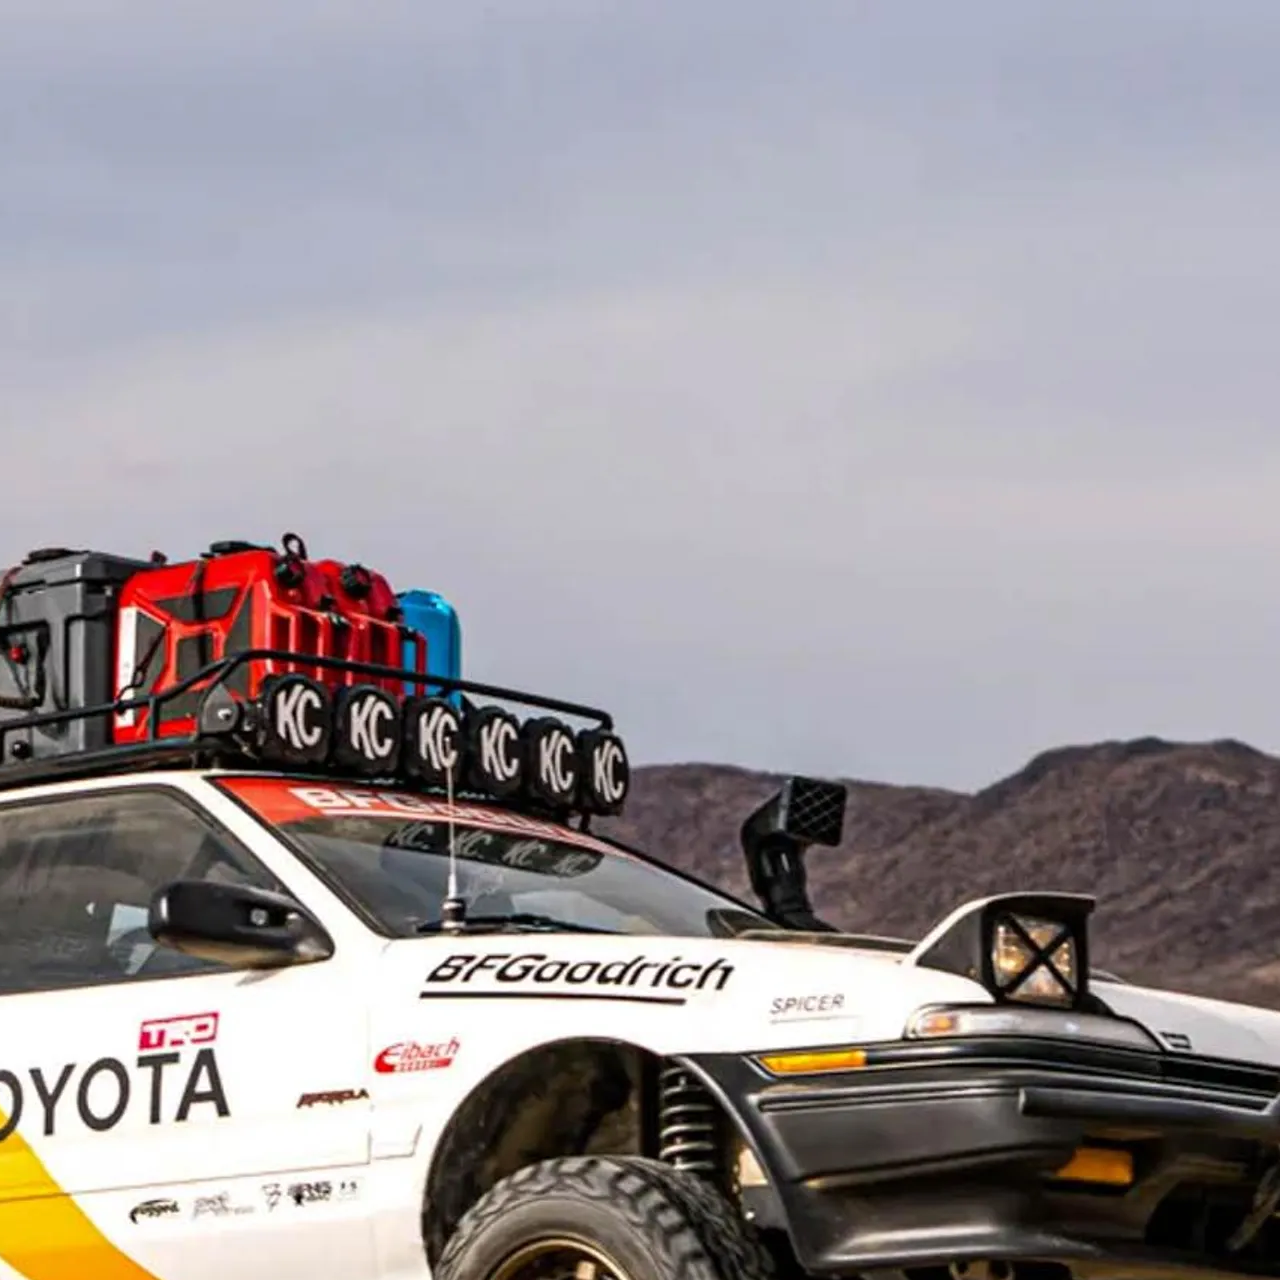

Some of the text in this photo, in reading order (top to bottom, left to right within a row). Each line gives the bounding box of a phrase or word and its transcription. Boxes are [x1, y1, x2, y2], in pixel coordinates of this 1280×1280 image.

[277, 684, 321, 749] KC
[351, 695, 393, 760] KC
[419, 706, 458, 770] KC
[481, 718, 519, 781] KC
[540, 730, 573, 793] KC
[594, 740, 624, 802] KC
[425, 954, 735, 991] BFGoodrich
[769, 993, 845, 1015] SPICER
[374, 1036, 460, 1074] Eibach
